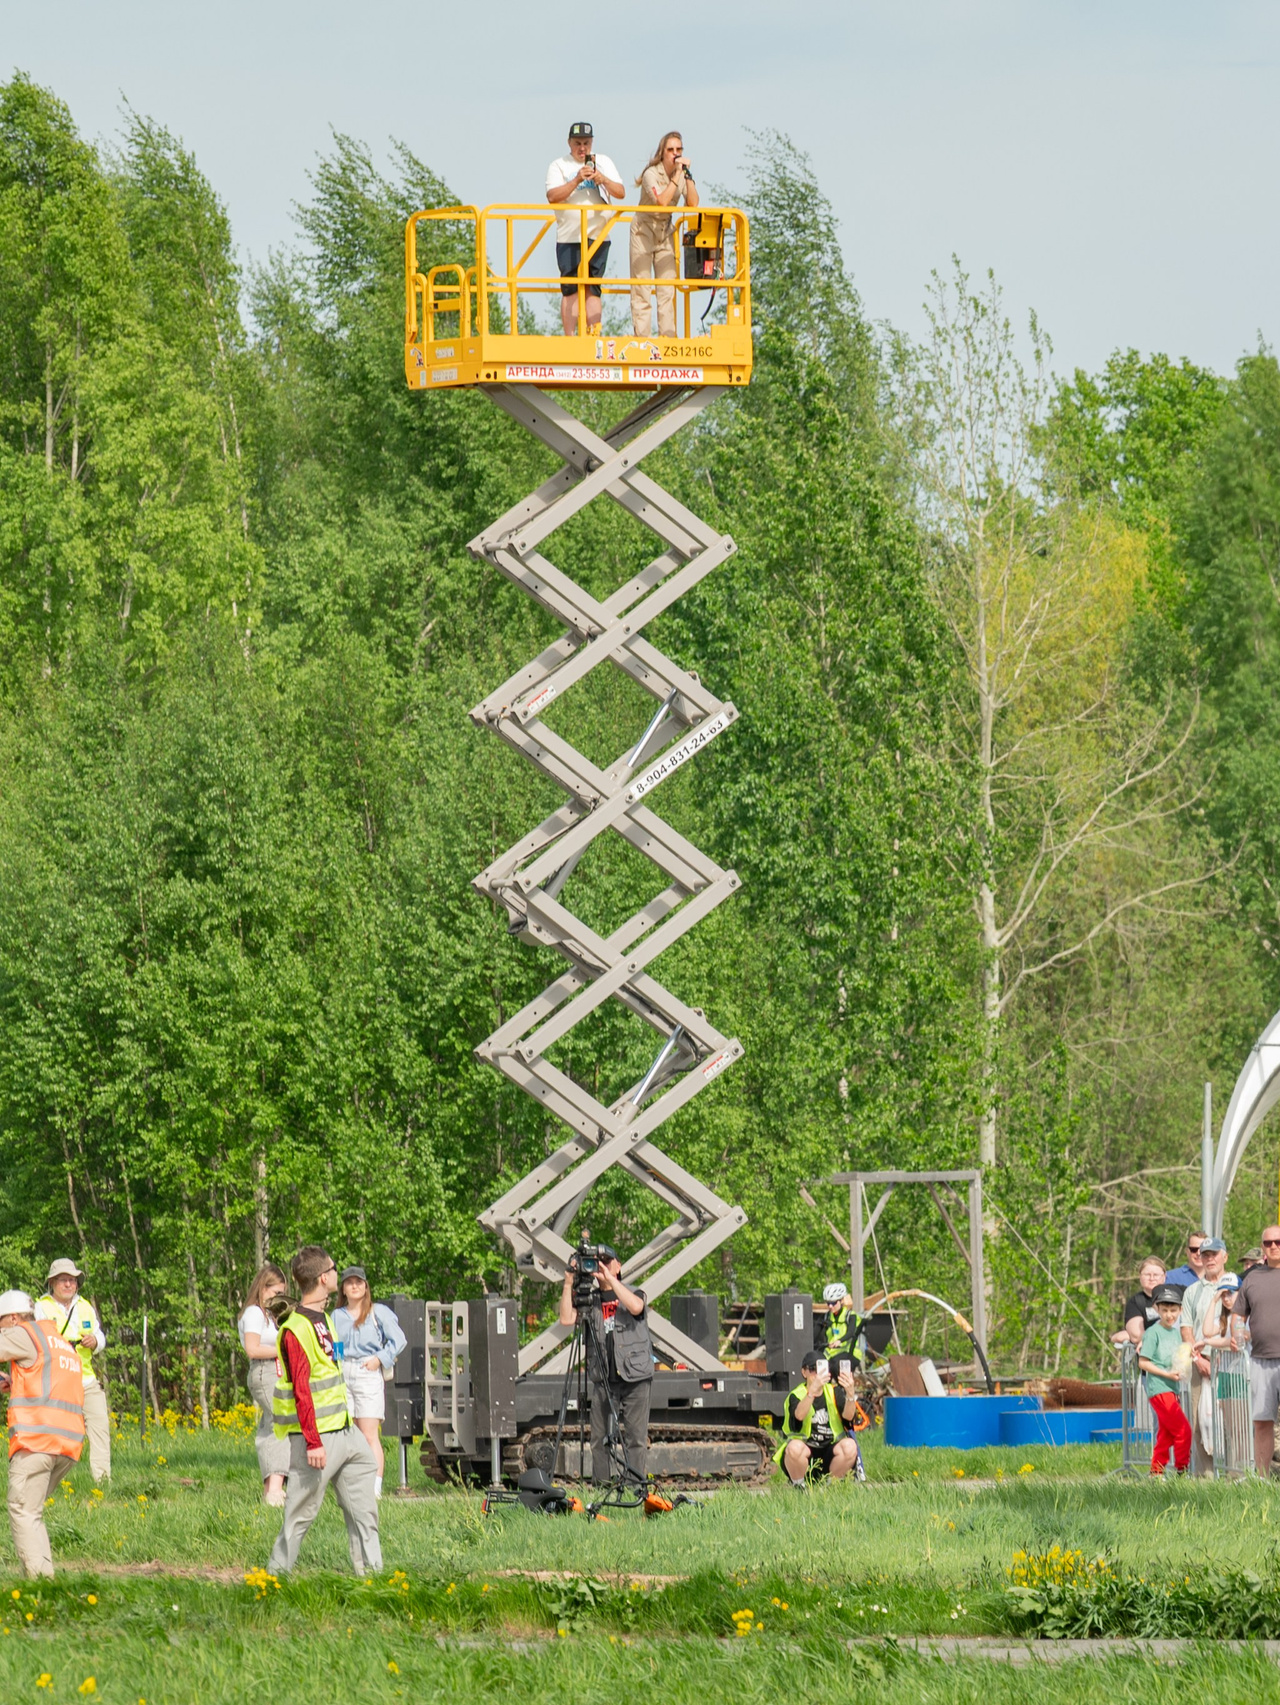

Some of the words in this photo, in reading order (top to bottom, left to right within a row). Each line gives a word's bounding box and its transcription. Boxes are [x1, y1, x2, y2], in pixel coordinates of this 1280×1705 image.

[663, 346, 713, 357] ZS1216C
[507, 366, 555, 378] АРЕНДА
[572, 368, 611, 379] 23-55-53
[633, 368, 699, 380] ПРОДАЖА
[636, 719, 723, 794] 8-904-831-24-63
